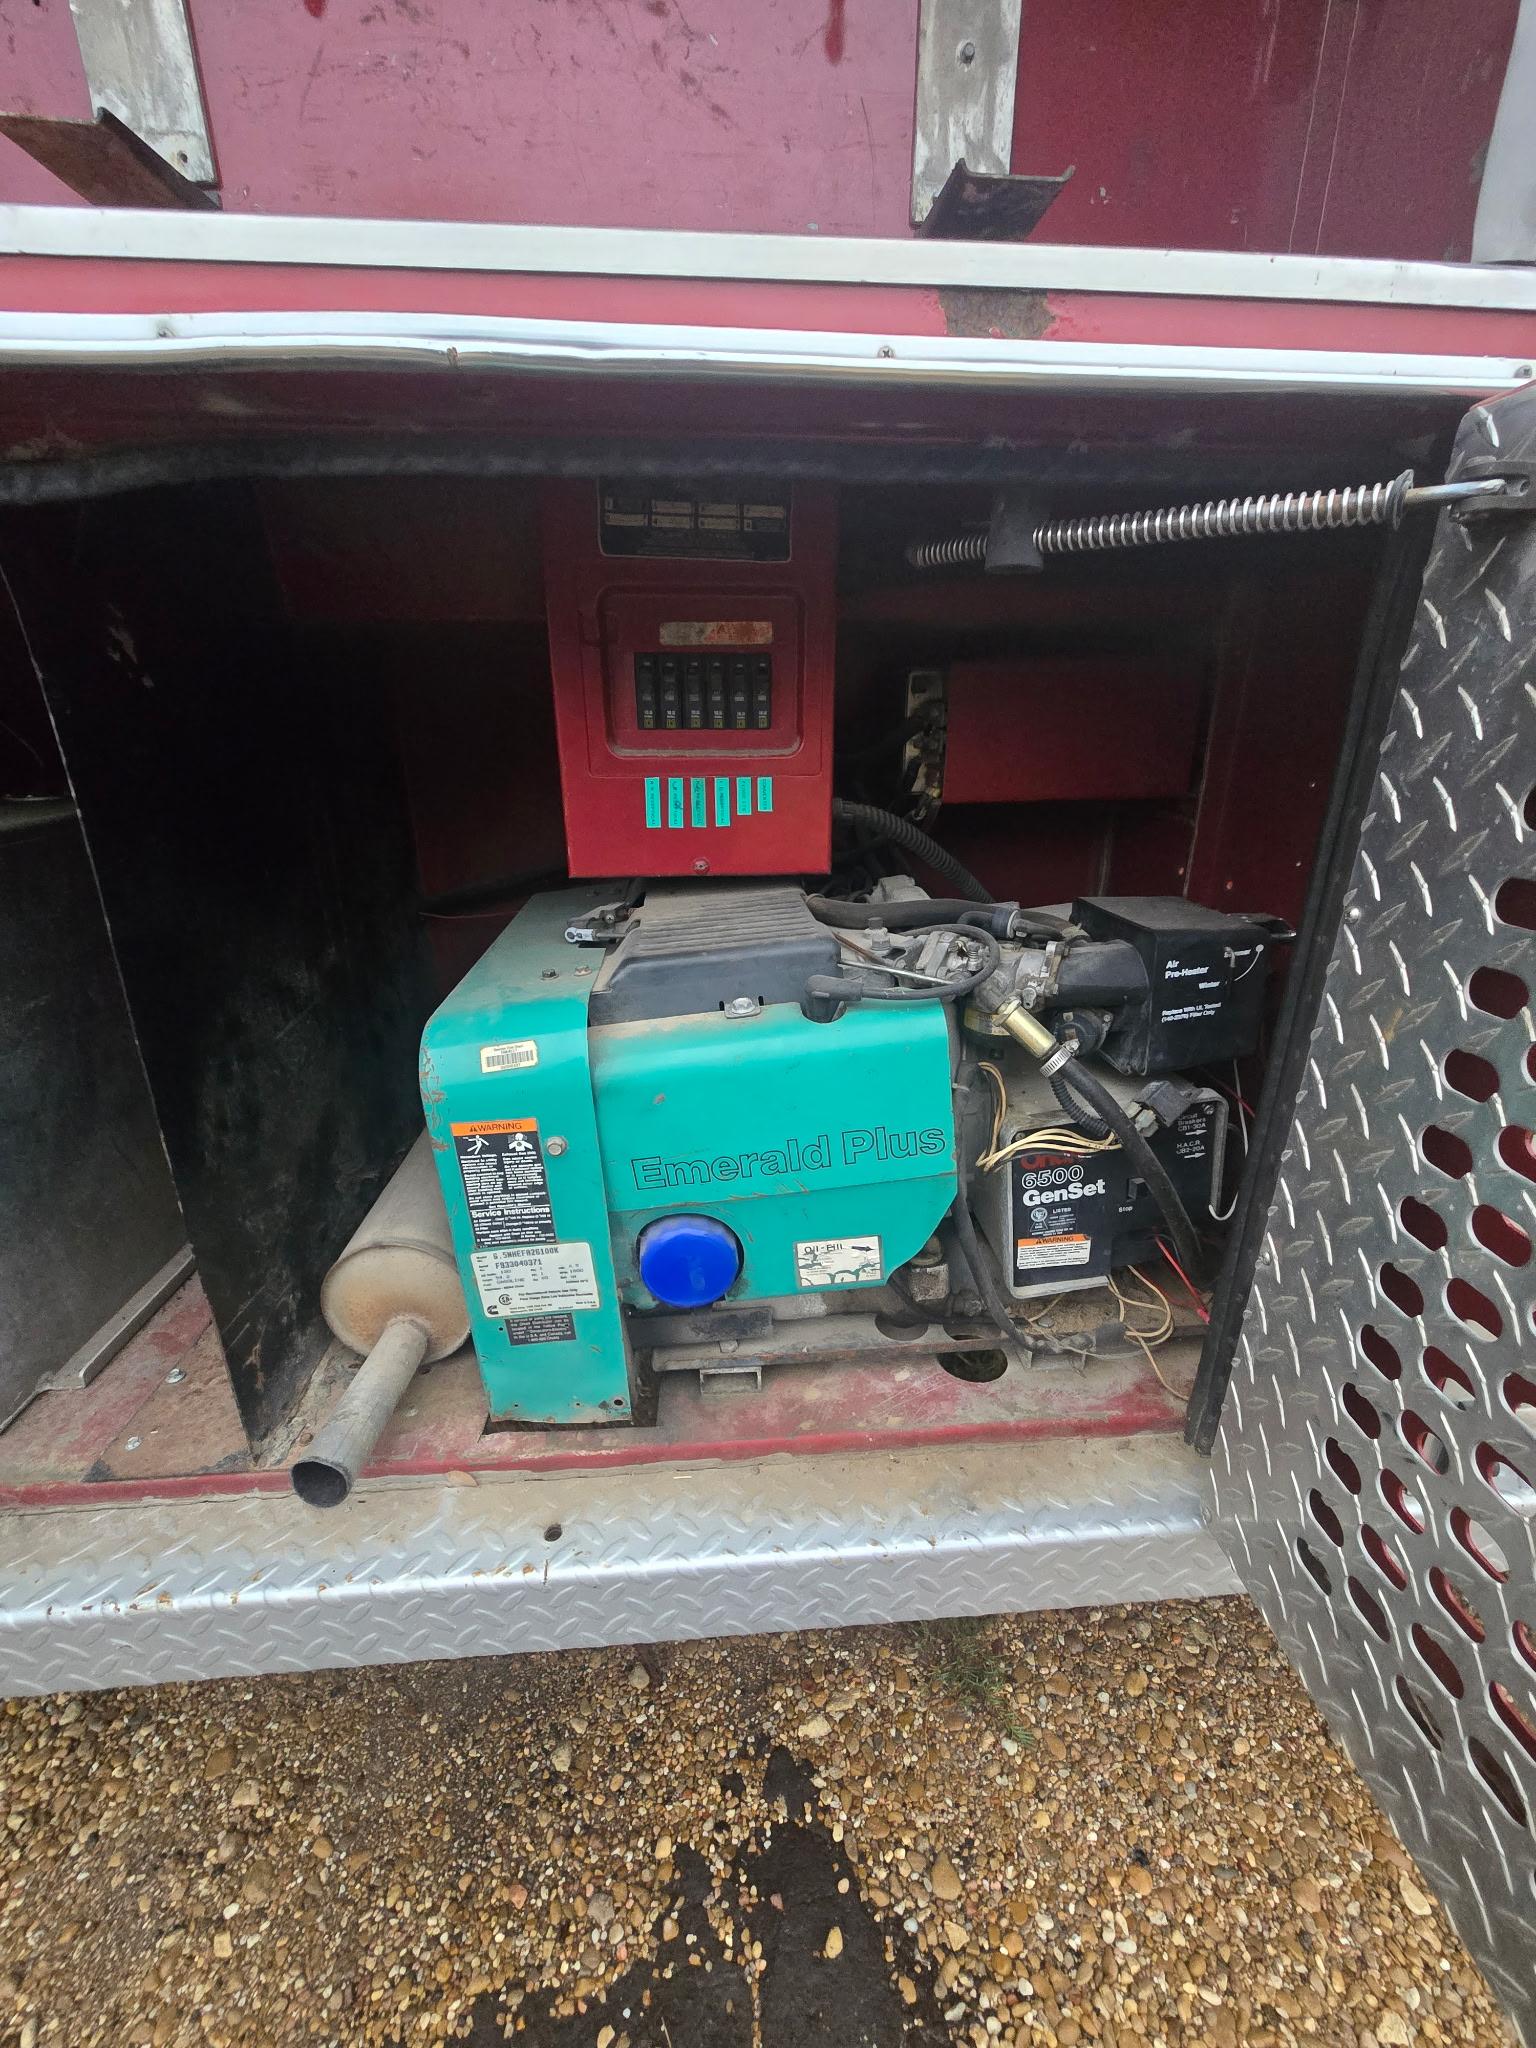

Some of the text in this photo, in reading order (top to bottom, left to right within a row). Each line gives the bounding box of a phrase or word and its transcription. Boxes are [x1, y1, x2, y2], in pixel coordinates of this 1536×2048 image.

[1165, 959, 1180, 970] Air
[1164, 966, 1210, 980] Pre-Heater
[477, 1122, 523, 1133] WARNING
[631, 1126, 946, 1191] Emerald Plus
[1021, 1164, 1085, 1190] 6500
[1022, 1178, 1106, 1207] GenSet
[471, 1206, 551, 1219] Service Instructions
